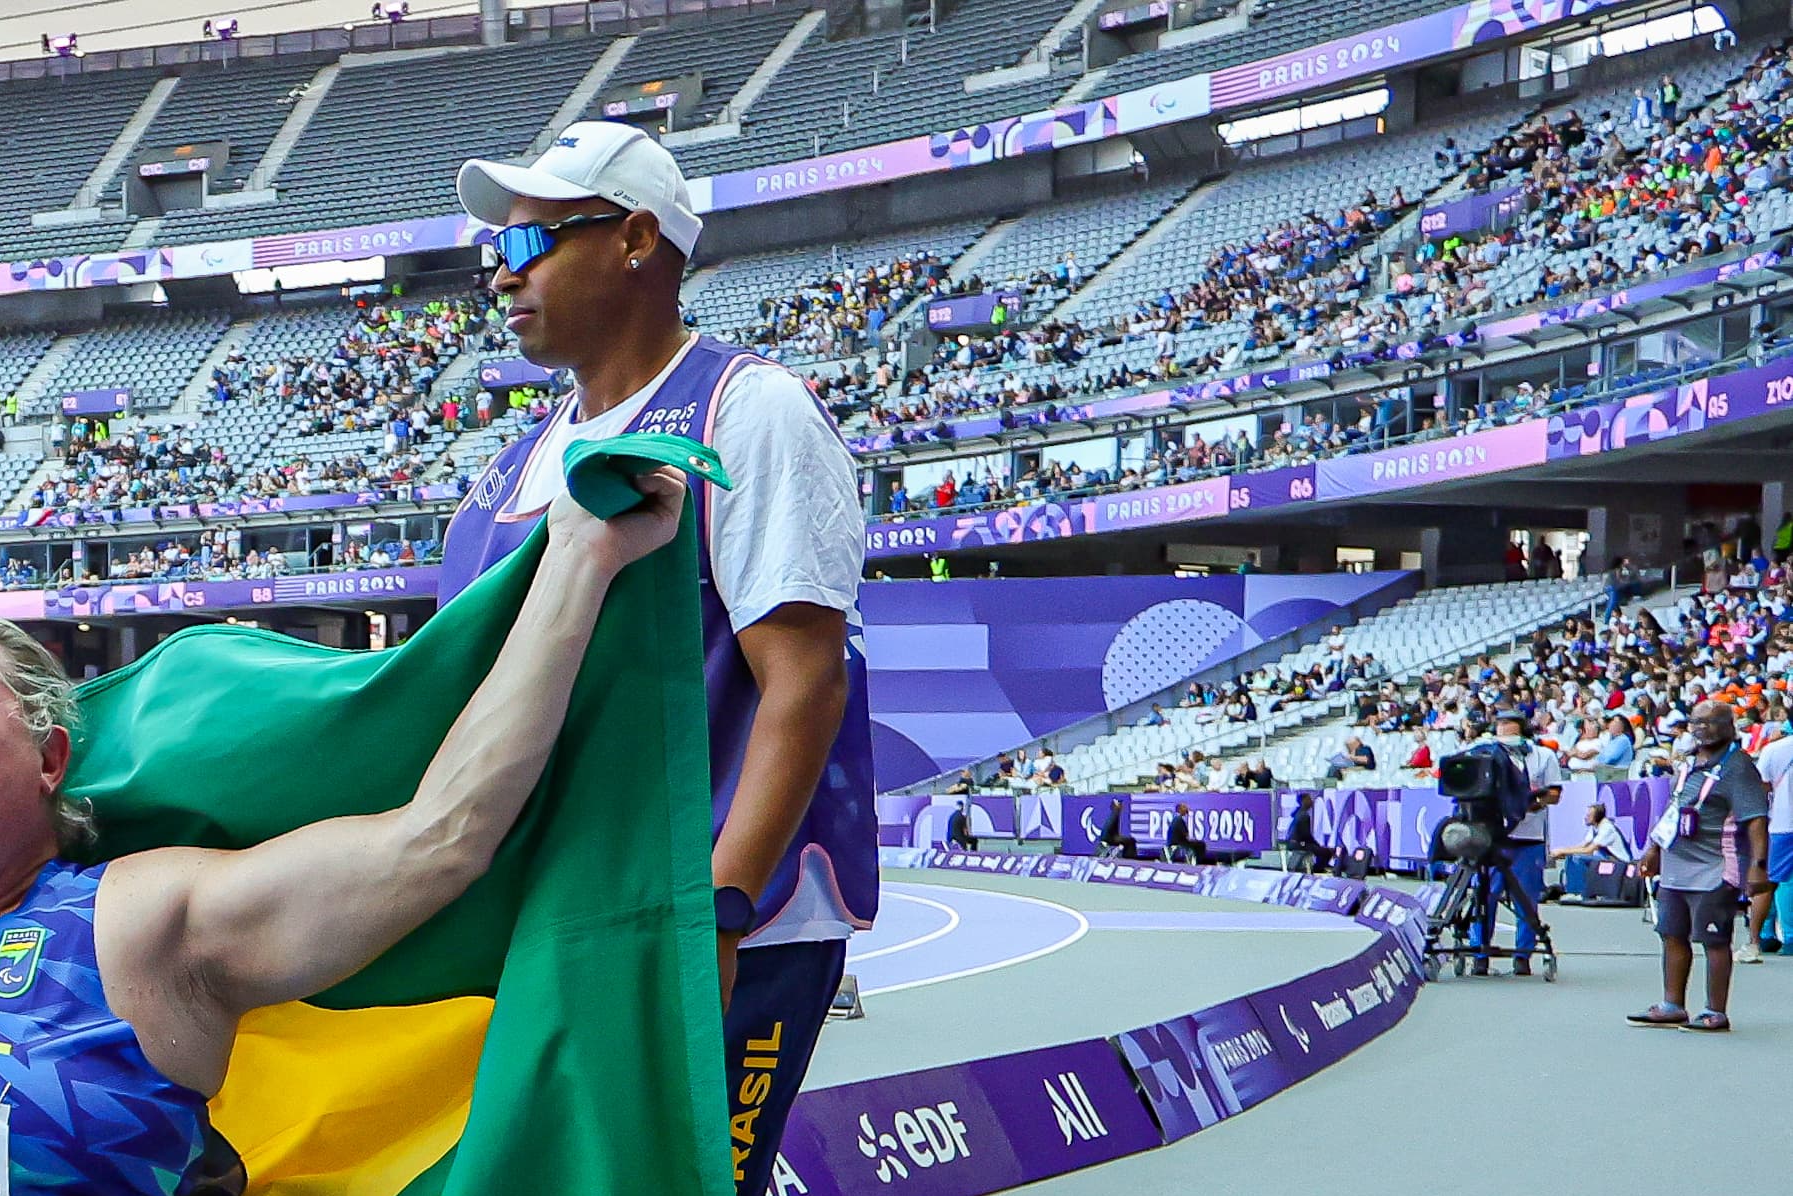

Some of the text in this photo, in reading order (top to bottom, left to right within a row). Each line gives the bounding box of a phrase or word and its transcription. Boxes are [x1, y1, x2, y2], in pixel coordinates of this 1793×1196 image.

[1259, 35, 1400, 89] PARIS 2024
[756, 157, 884, 193] PARIS 2024
[294, 230, 413, 257] PARIS 2024
[639, 401, 697, 428] PARIS
[1708, 393, 1729, 419] A5
[1372, 445, 1486, 481] PARIS 2024
[1107, 489, 1214, 520] PARIS 2024
[1230, 477, 1313, 509] B5 A6
[888, 527, 936, 548] 2024
[183, 590, 205, 606] C5
[305, 575, 405, 596] PARIS 2024
[1209, 810, 1254, 842] 2024
[730, 1021, 782, 1193] RASIL
